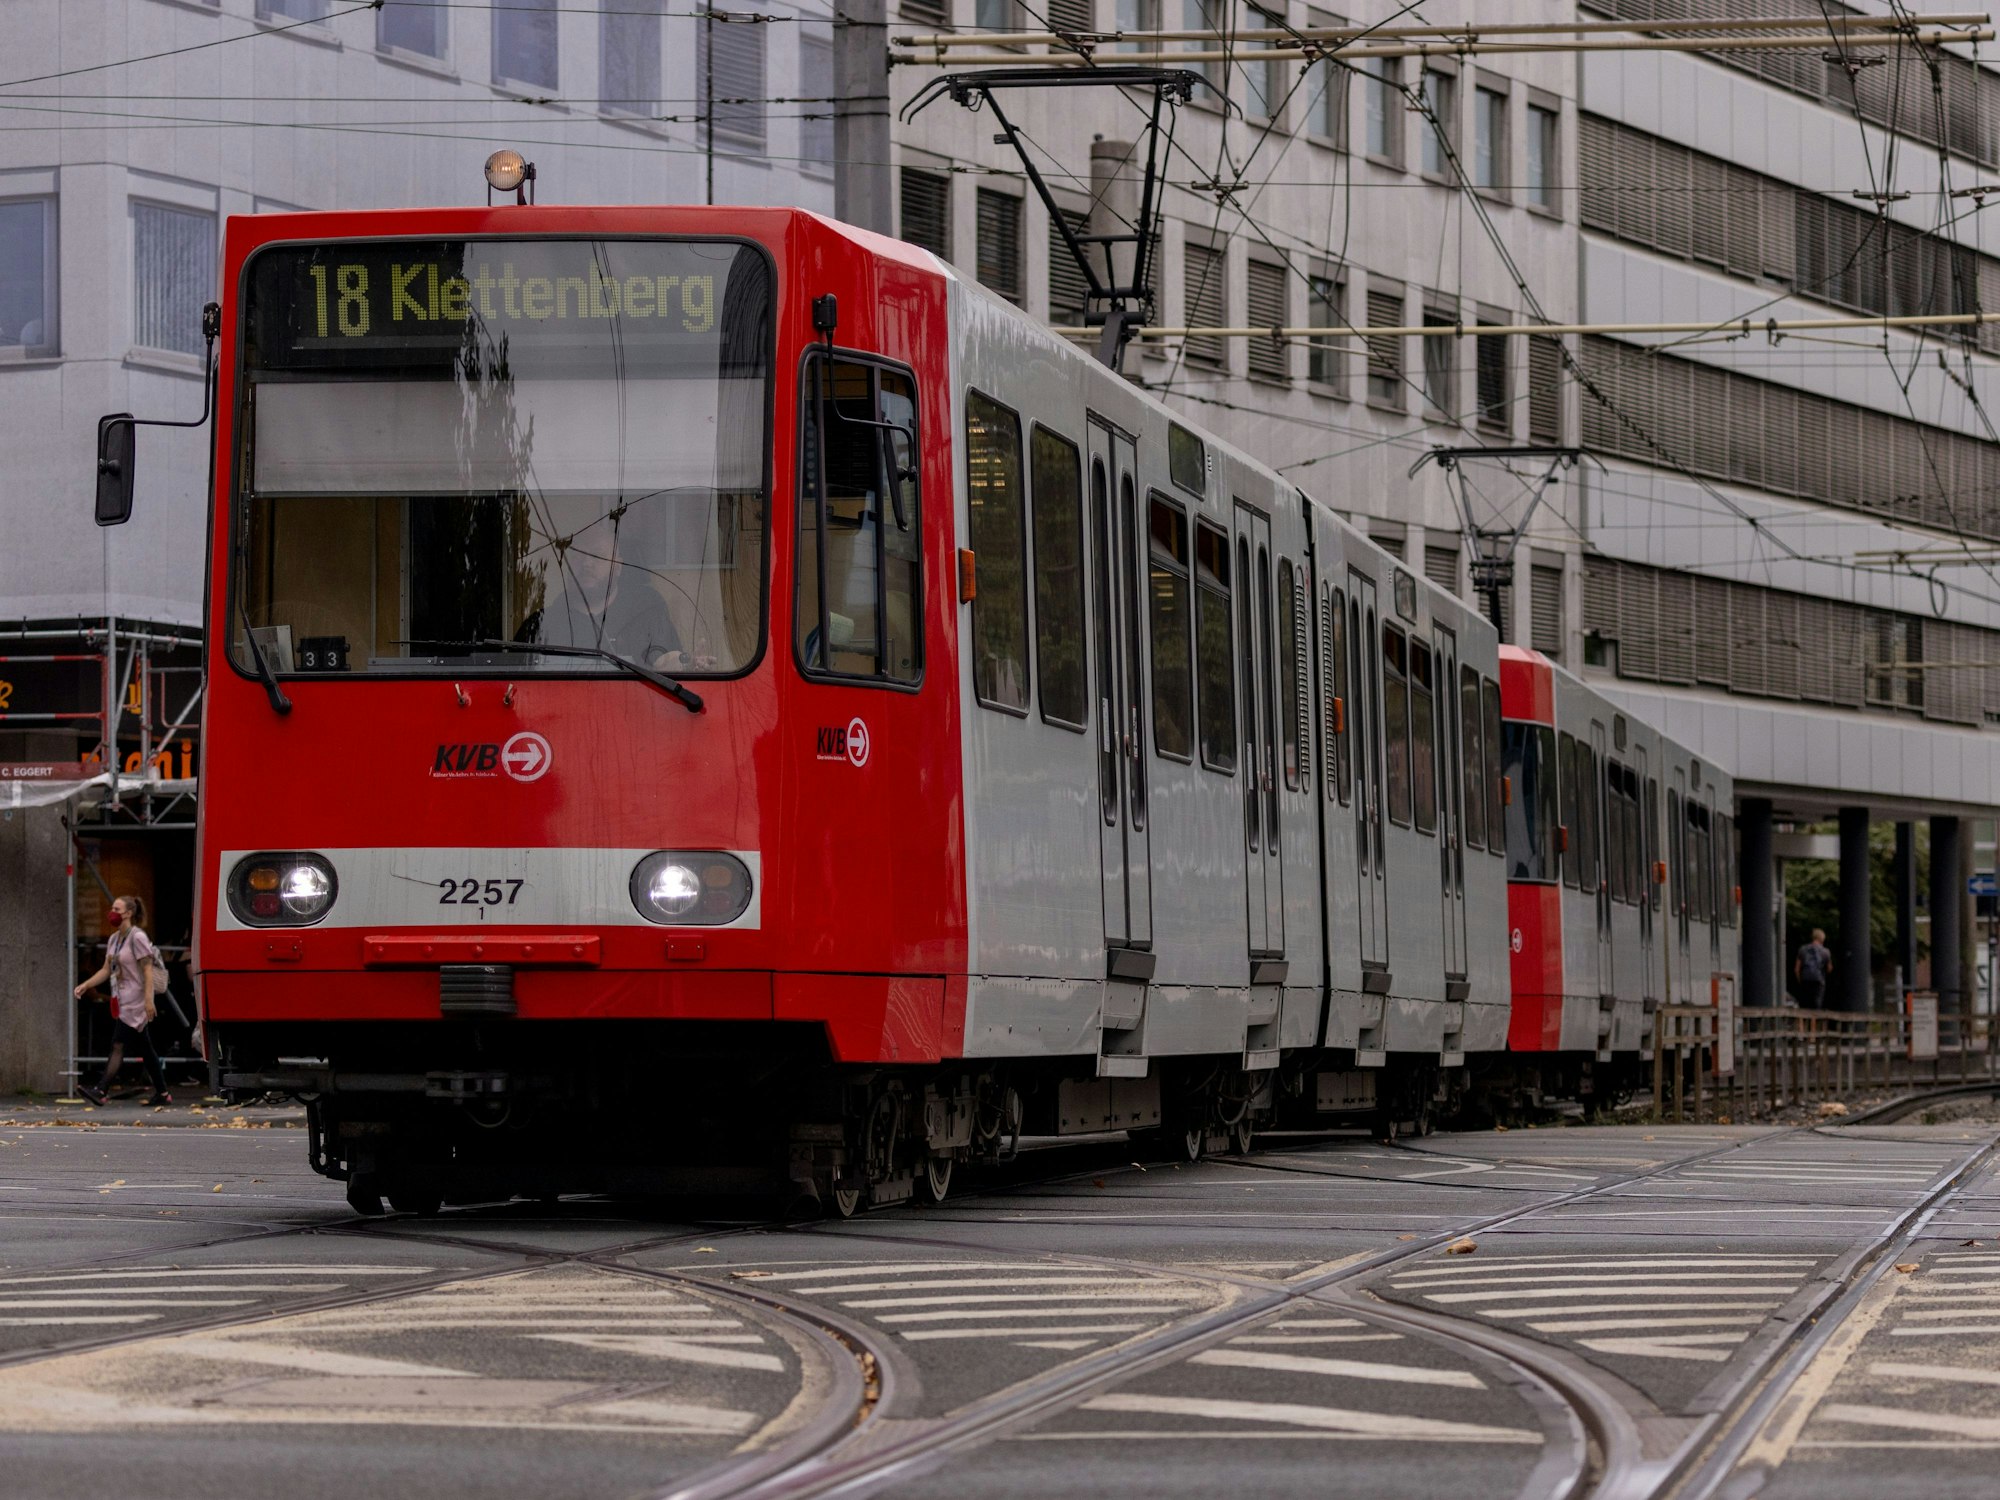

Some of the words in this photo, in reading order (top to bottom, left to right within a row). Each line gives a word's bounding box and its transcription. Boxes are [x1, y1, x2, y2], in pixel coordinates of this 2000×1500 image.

[310, 263, 370, 337] 18
[391, 262, 714, 333] Klettenberg
[817, 727, 846, 754] KVB
[434, 744, 500, 771] KVB
[1, 767, 12, 777] C.
[13, 767, 53, 777] EGGERT
[439, 878, 524, 905] 2257
[478, 906, 484, 920] 1
